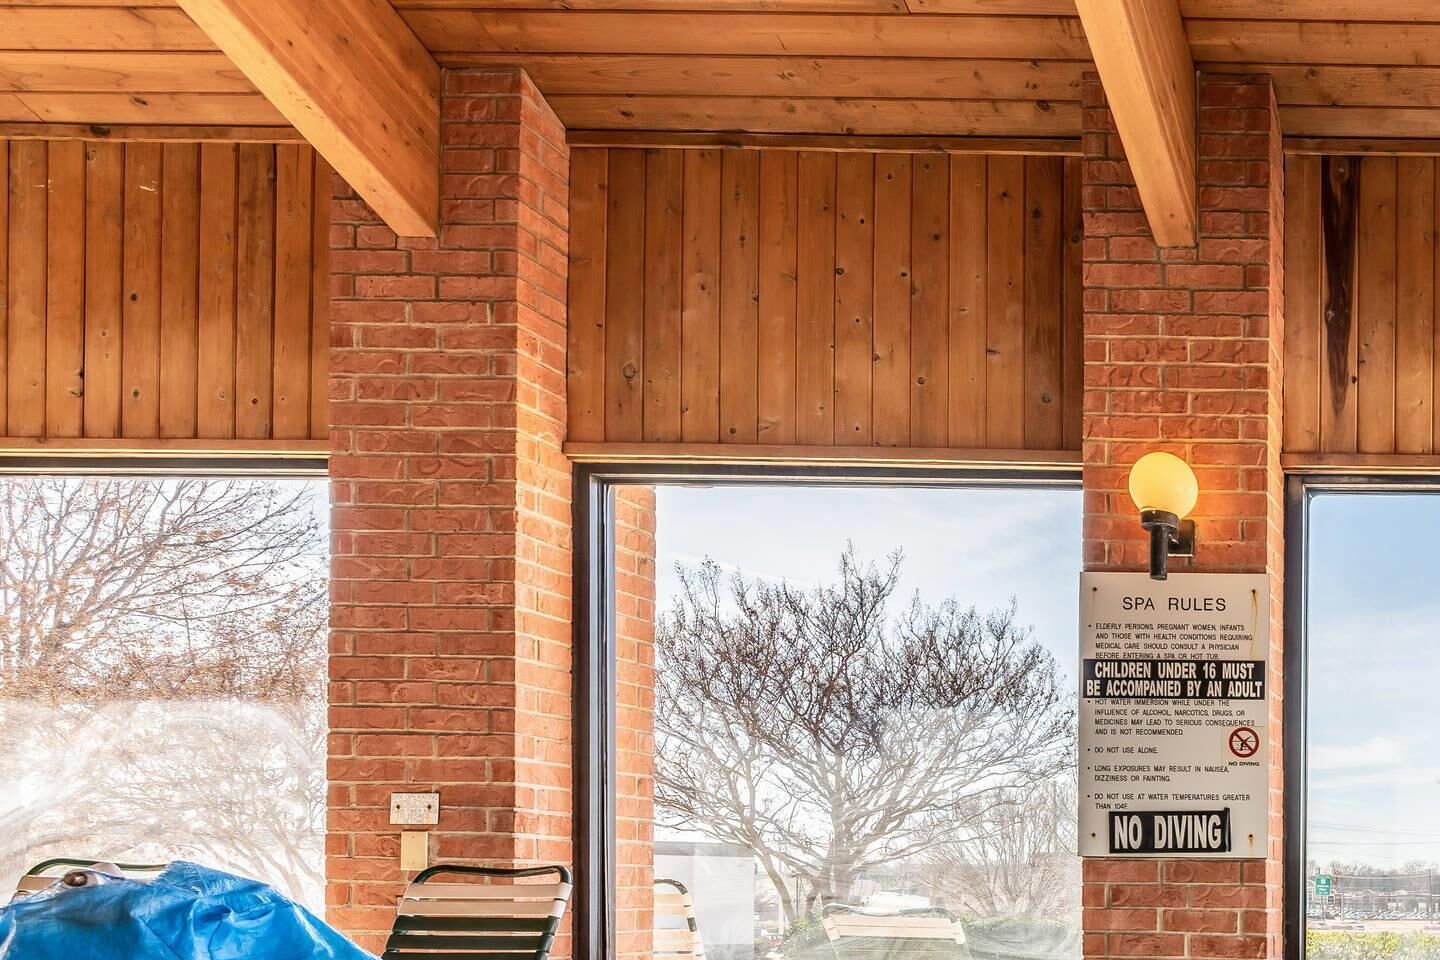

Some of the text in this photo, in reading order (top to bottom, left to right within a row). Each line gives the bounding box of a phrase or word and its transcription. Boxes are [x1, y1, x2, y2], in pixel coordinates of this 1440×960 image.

[1122, 596, 1226, 611] SPA RULES
[1094, 662, 1255, 680] CHILDREN UNDER 16 MUST
[1086, 679, 1263, 698] BE ACCOMPANIED BY AN ADULT
[1114, 815, 1221, 849] NO DIVING
